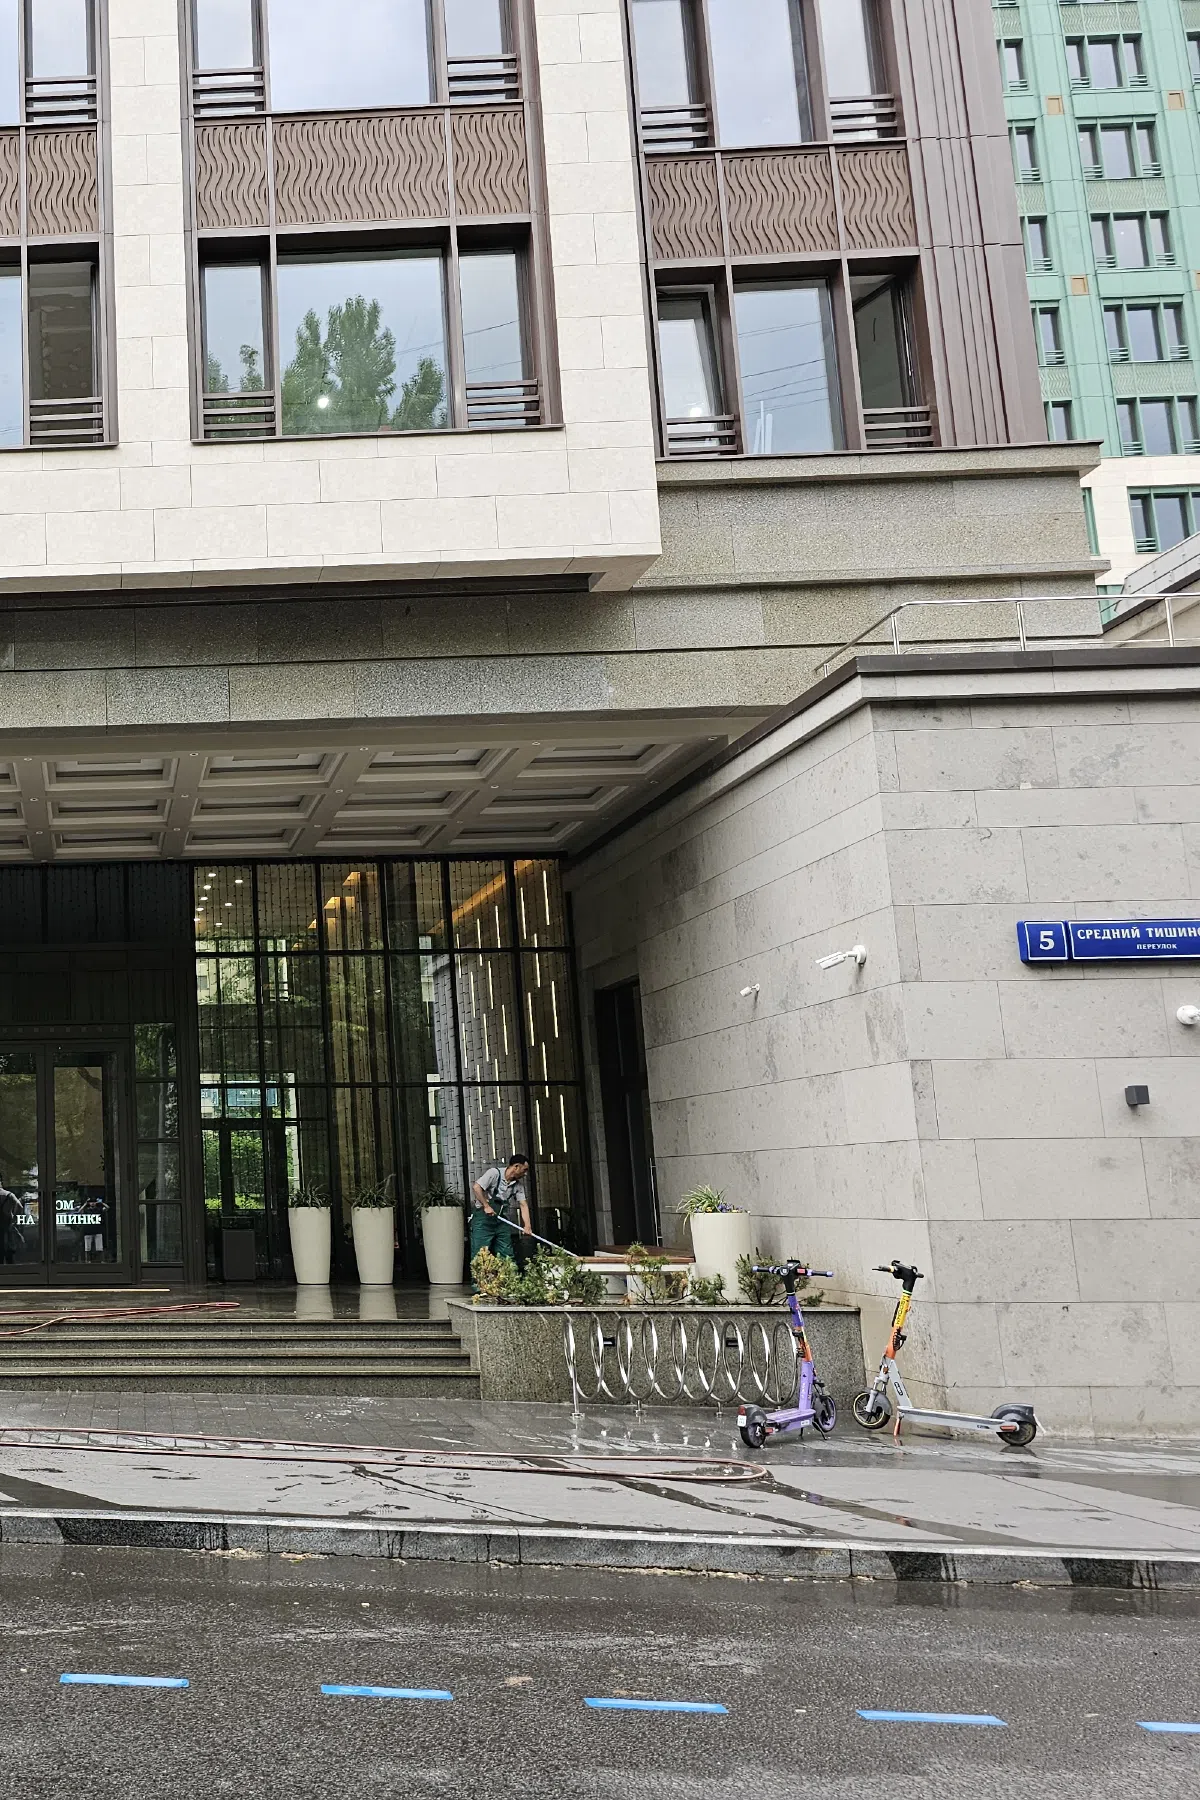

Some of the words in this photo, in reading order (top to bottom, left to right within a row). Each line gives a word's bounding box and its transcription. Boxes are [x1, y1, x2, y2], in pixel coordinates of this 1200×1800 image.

[1039, 930, 1055, 950] 5
[1077, 926, 1141, 940] СРЕДНИЙ
[16, 1214, 36, 1225] НА
